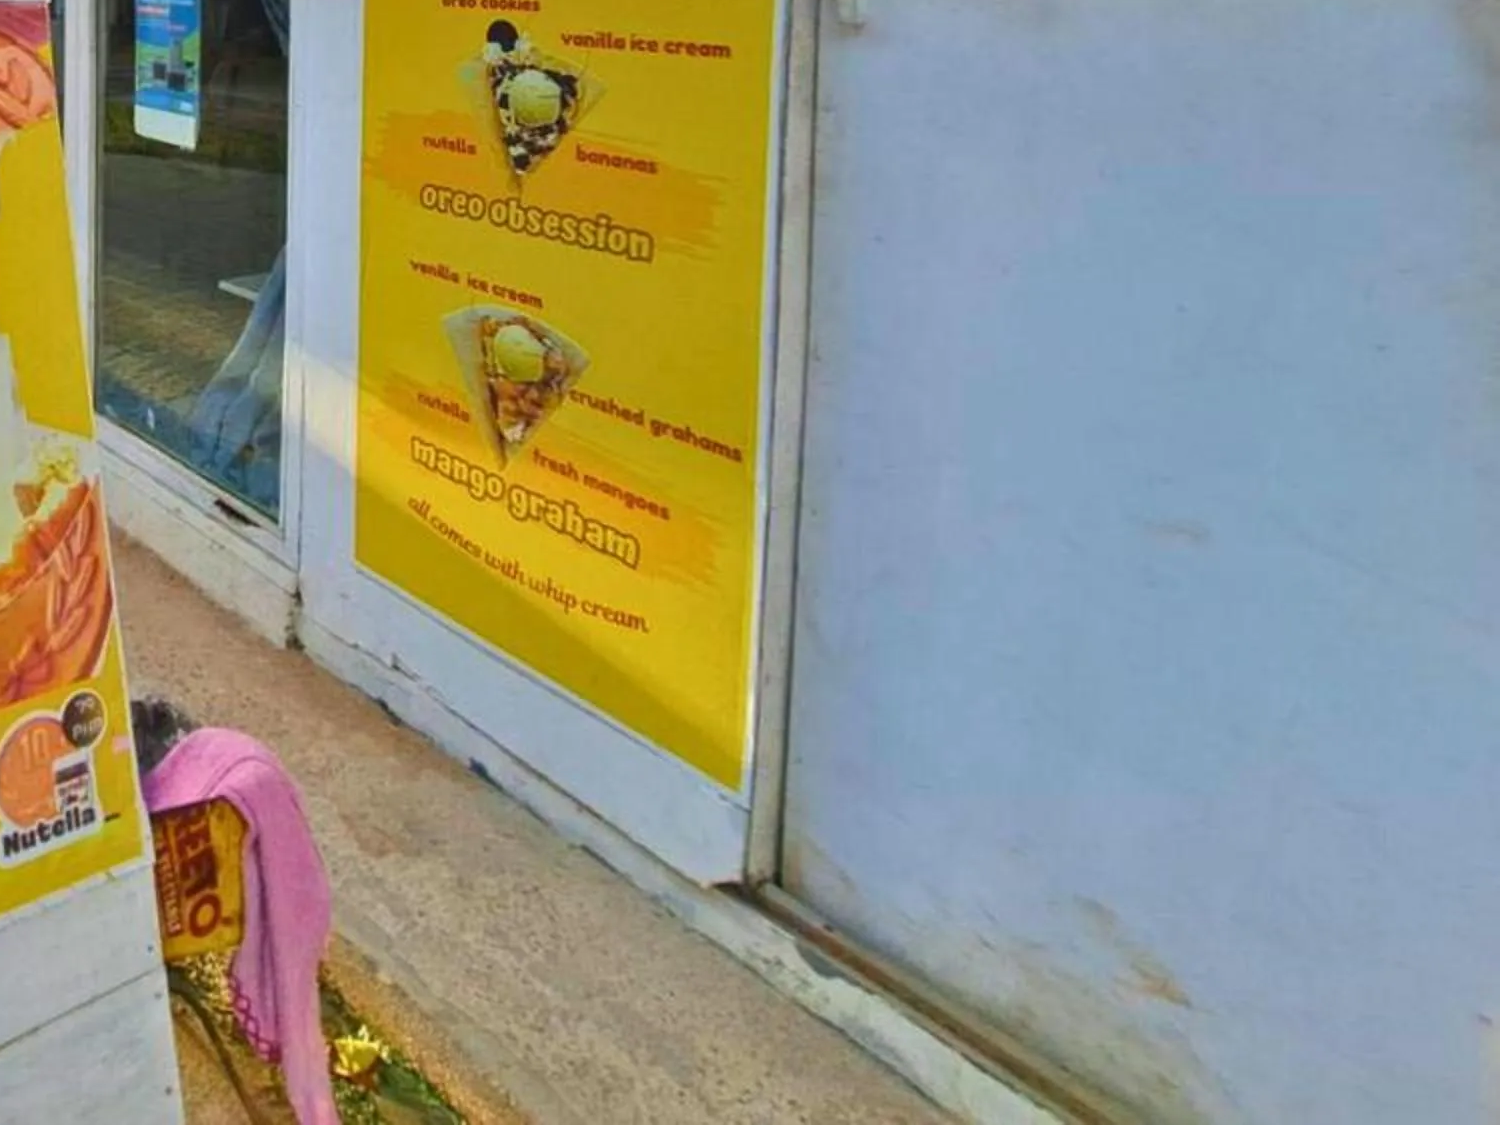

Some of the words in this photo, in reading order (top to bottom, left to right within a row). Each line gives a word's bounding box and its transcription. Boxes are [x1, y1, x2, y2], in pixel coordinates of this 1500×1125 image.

[560, 30, 627, 52] vanilla
[629, 33, 659, 54] ice
[664, 39, 732, 60] cream
[422, 133, 478, 157] nutella
[575, 144, 659, 176] bananas
[420, 182, 486, 220] oreo
[488, 197, 655, 264] obsession
[409, 259, 461, 285] vanilla
[466, 273, 489, 293] ice
[492, 282, 544, 309] cream
[416, 391, 471, 425] nutella
[568, 388, 646, 428] crushed
[649, 415, 743, 464] grahams
[410, 436, 506, 503] mango
[506, 485, 641, 570] graham
[532, 447, 580, 481] fresh
[582, 473, 671, 522] mangoes
[406, 494, 431, 523] all
[430, 515, 484, 560] comes
[484, 548, 527, 587] with
[528, 575, 578, 615] whip
[580, 599, 650, 633] cream
[2, 805, 98, 858] Nutella
